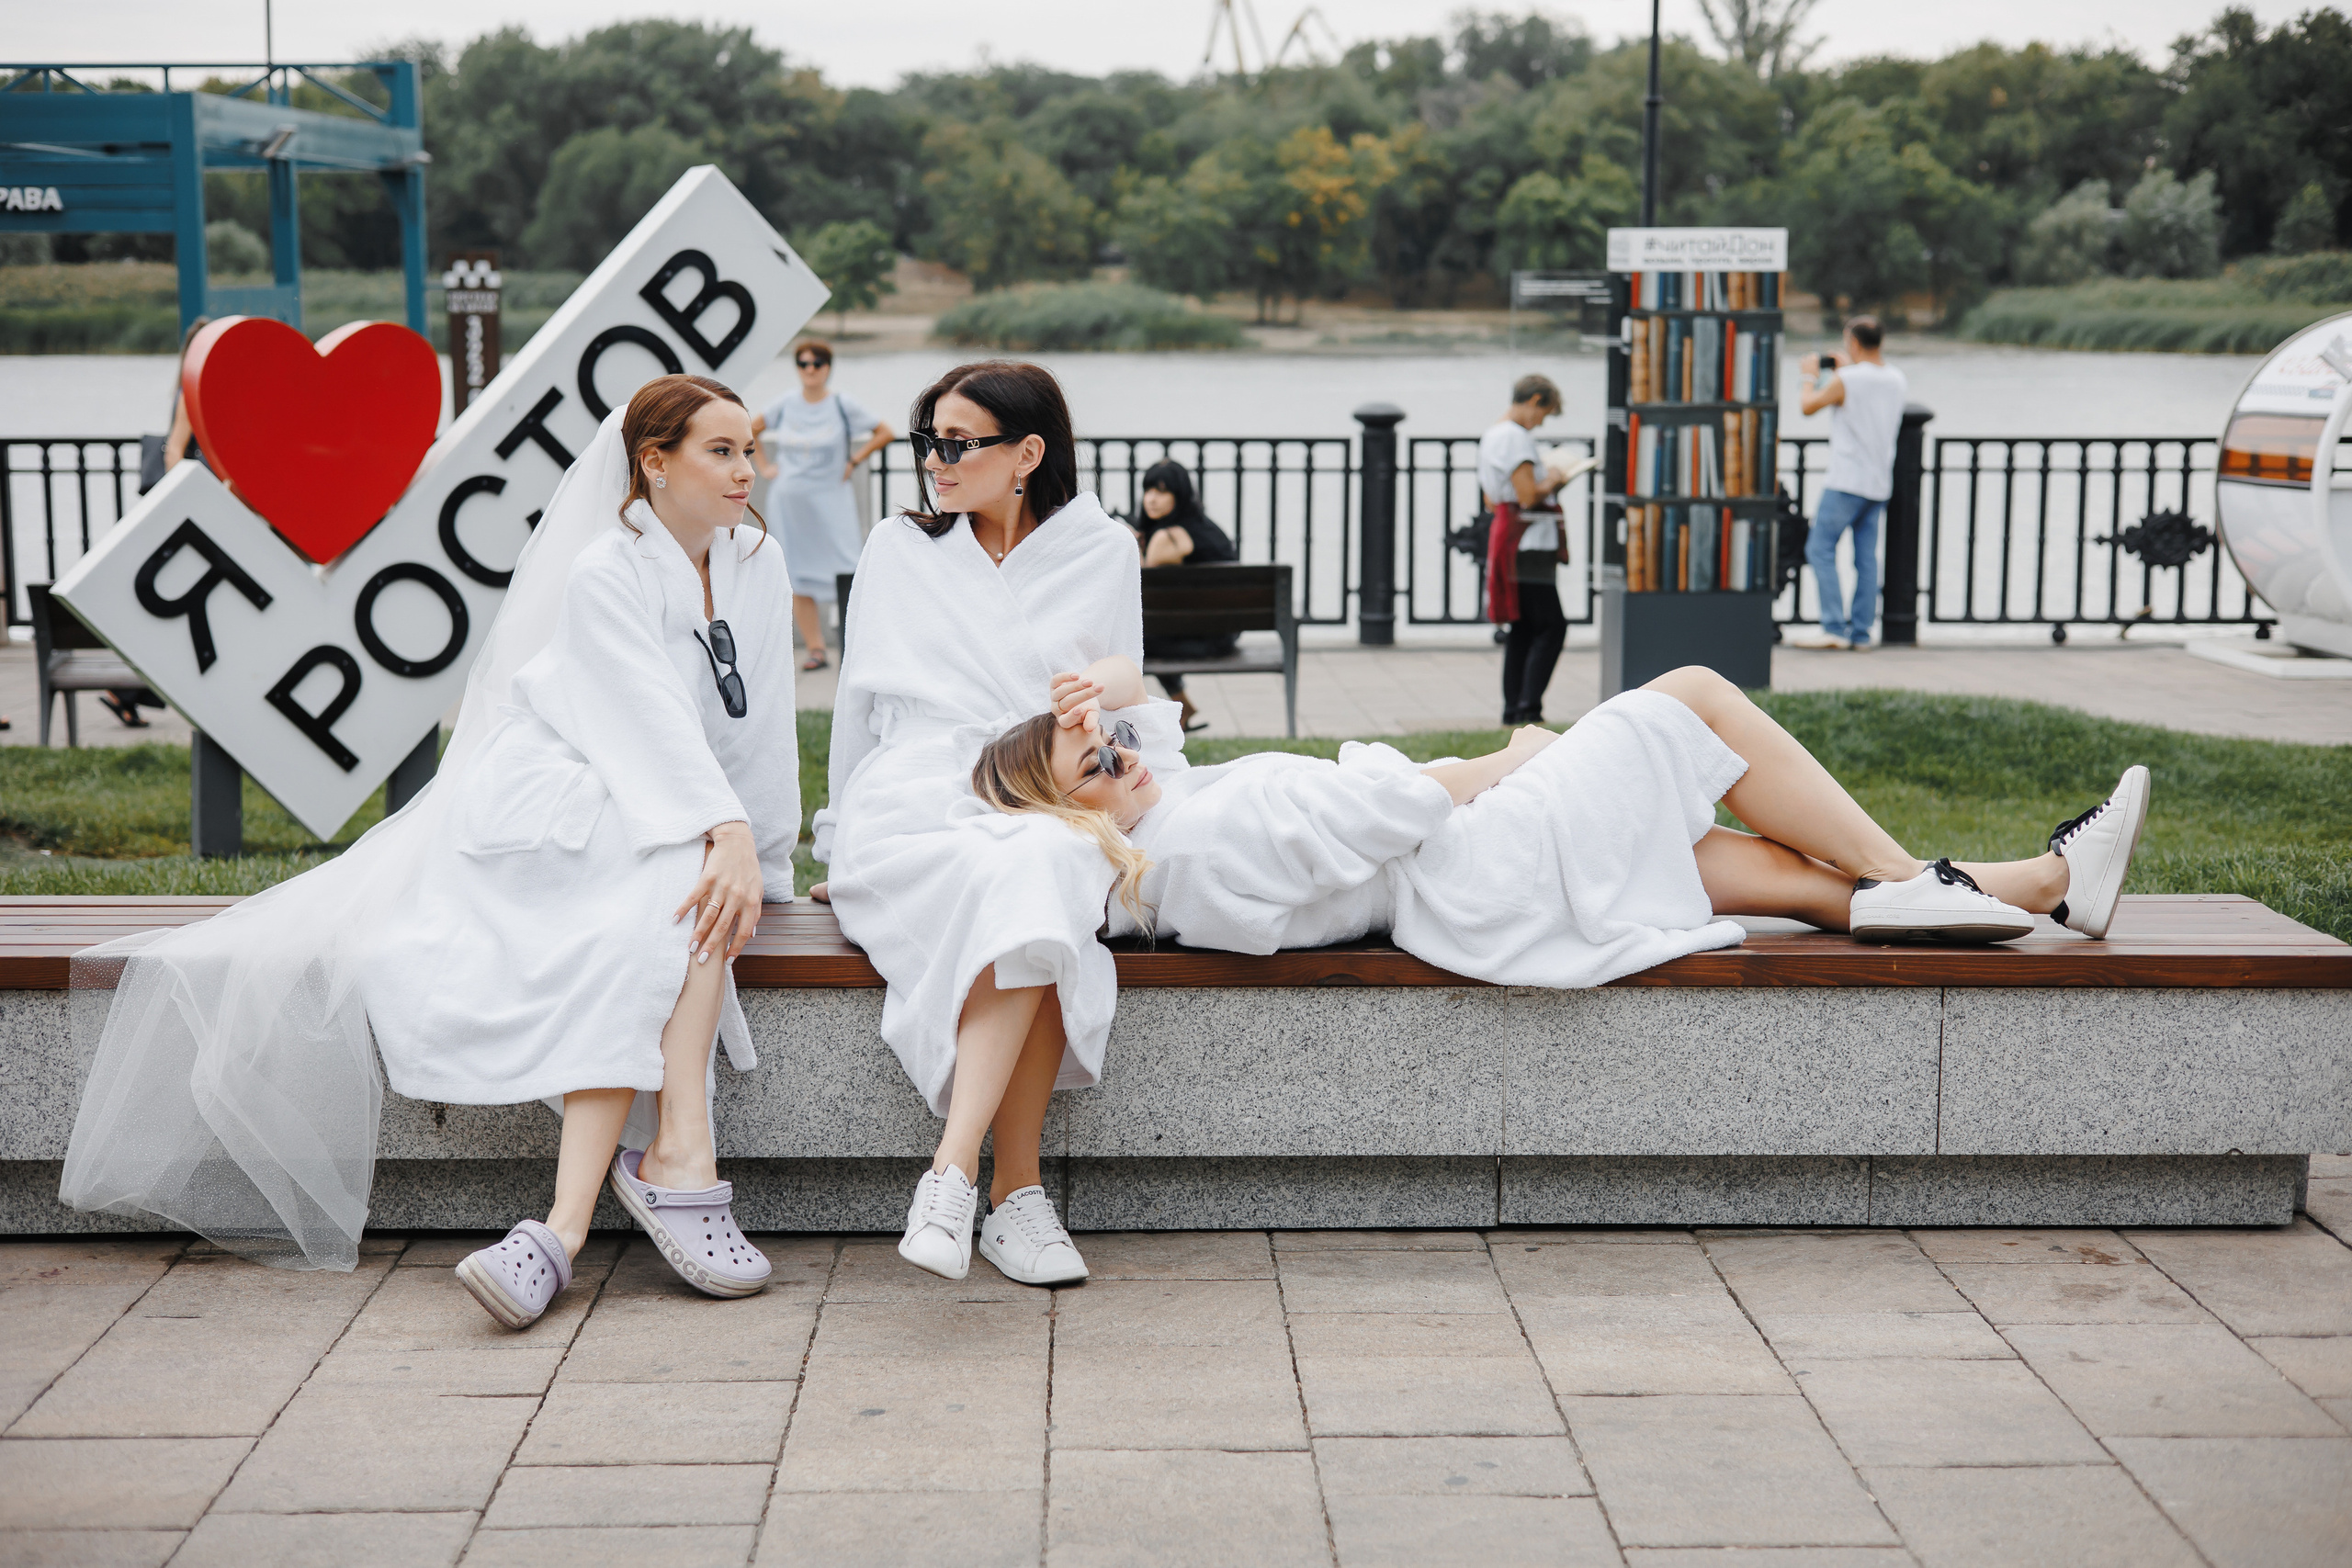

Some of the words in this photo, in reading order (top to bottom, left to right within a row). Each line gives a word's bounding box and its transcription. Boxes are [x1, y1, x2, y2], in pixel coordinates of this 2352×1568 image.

[264, 248, 758, 773] РОСТОВ
[134, 517, 273, 674] Я
[1016, 1190, 1043, 1200] LACOSTE
[653, 1227, 709, 1285] crocs
